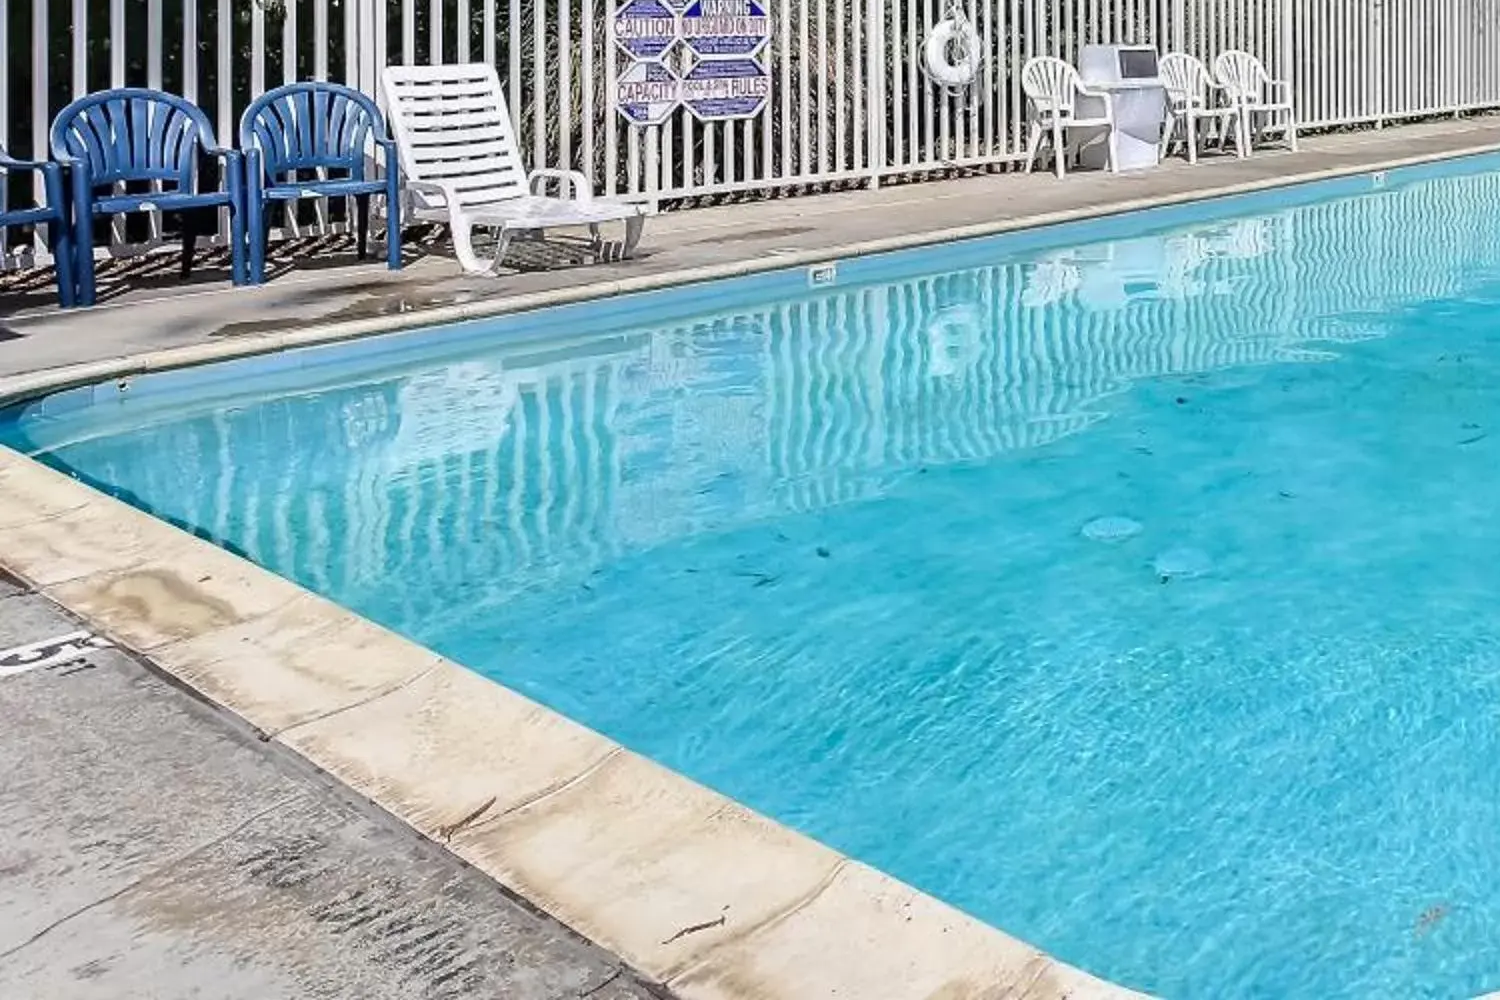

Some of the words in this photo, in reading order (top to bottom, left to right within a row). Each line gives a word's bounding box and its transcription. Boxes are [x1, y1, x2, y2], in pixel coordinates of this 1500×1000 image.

[701, 0, 750, 16] WARNING
[614, 18, 675, 36] CAUTION
[618, 81, 678, 101] CAPACITY
[732, 78, 768, 96] RULES
